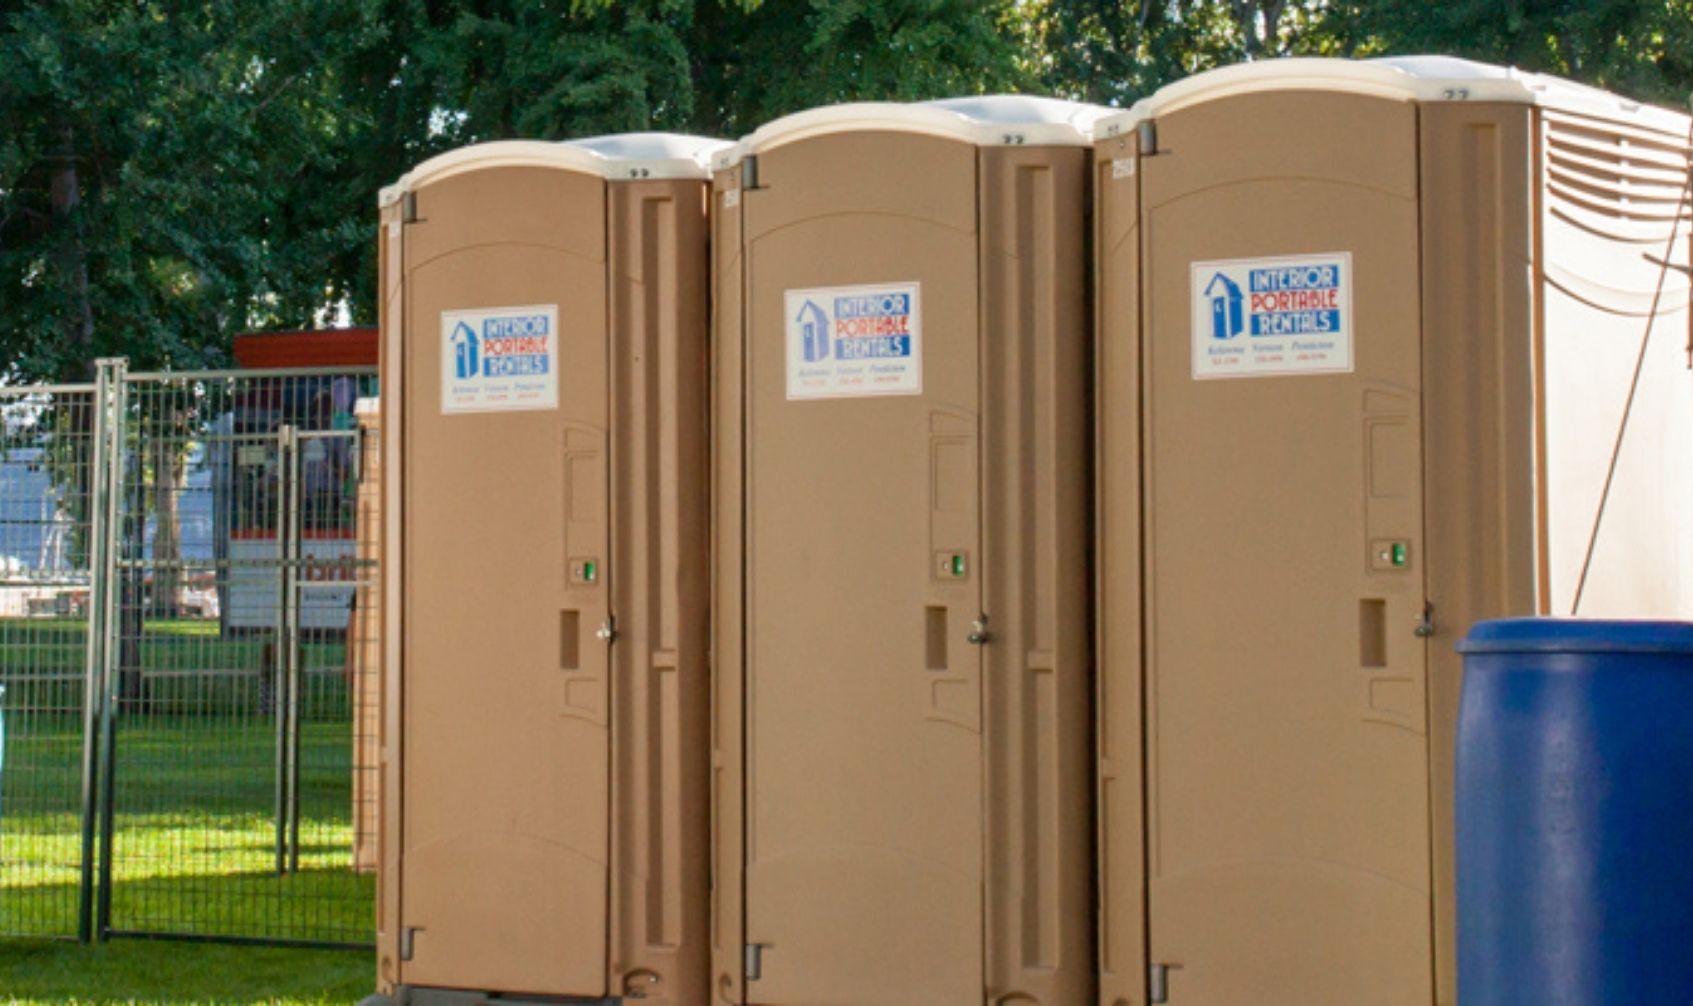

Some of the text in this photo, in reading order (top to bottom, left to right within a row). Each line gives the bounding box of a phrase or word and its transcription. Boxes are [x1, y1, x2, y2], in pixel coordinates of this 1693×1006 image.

[1253, 267, 1334, 291] INTERIOR
[838, 295, 905, 317] INTERIOR
[1251, 289, 1338, 312] PORTABLE
[836, 315, 909, 338] PORTABLE
[1260, 312, 1331, 335] RENTALS
[484, 336, 548, 355] PORTABLE
[843, 336, 902, 358] RENTALS
